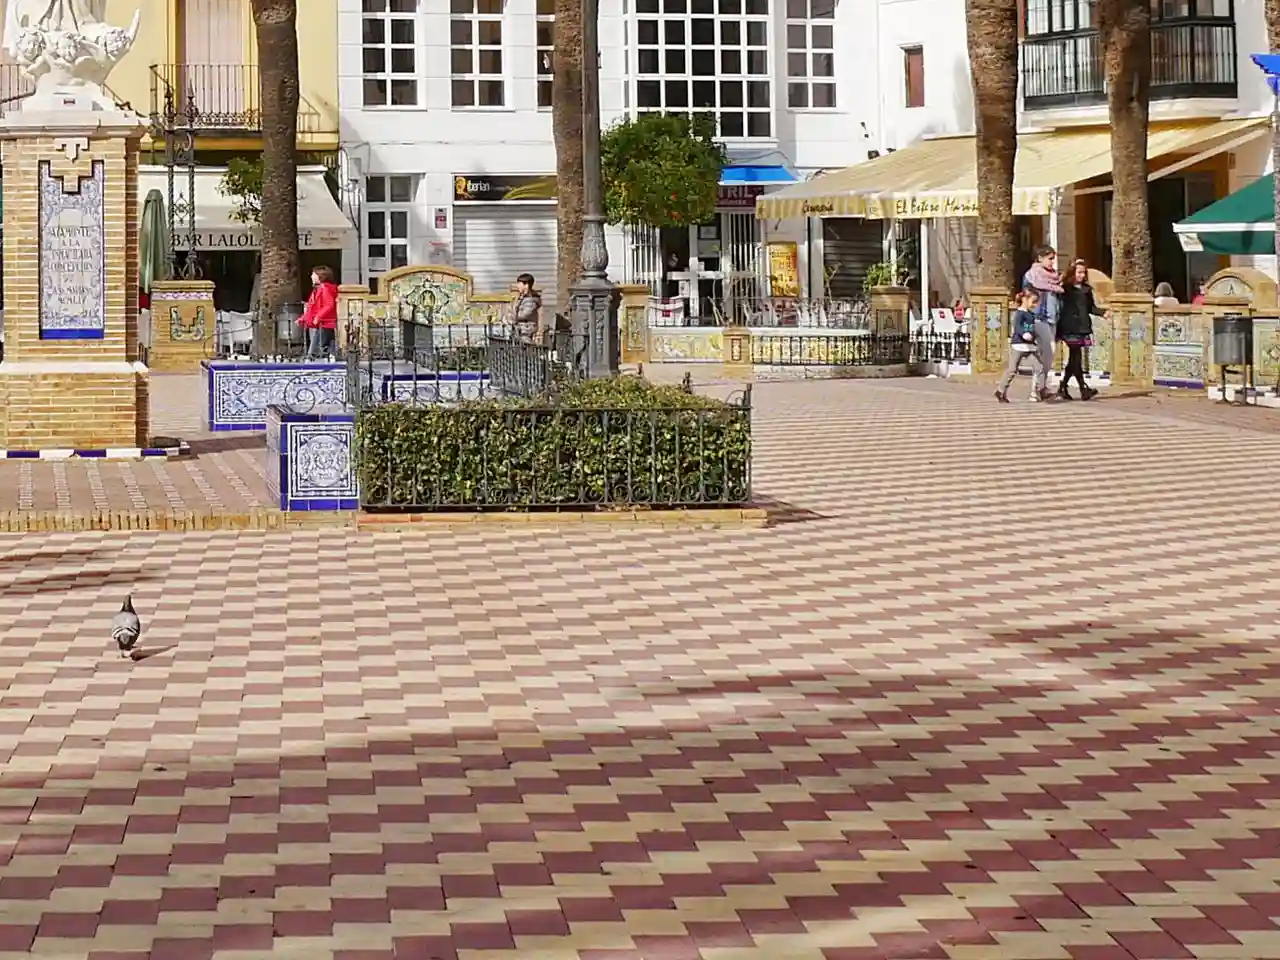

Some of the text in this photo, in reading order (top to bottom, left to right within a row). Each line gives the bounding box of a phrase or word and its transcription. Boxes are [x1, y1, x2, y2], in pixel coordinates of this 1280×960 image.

[719, 186, 753, 198] TRIL
[896, 197, 908, 214] El
[171, 233, 204, 247] BAR
[208, 233, 262, 247] LALOL
